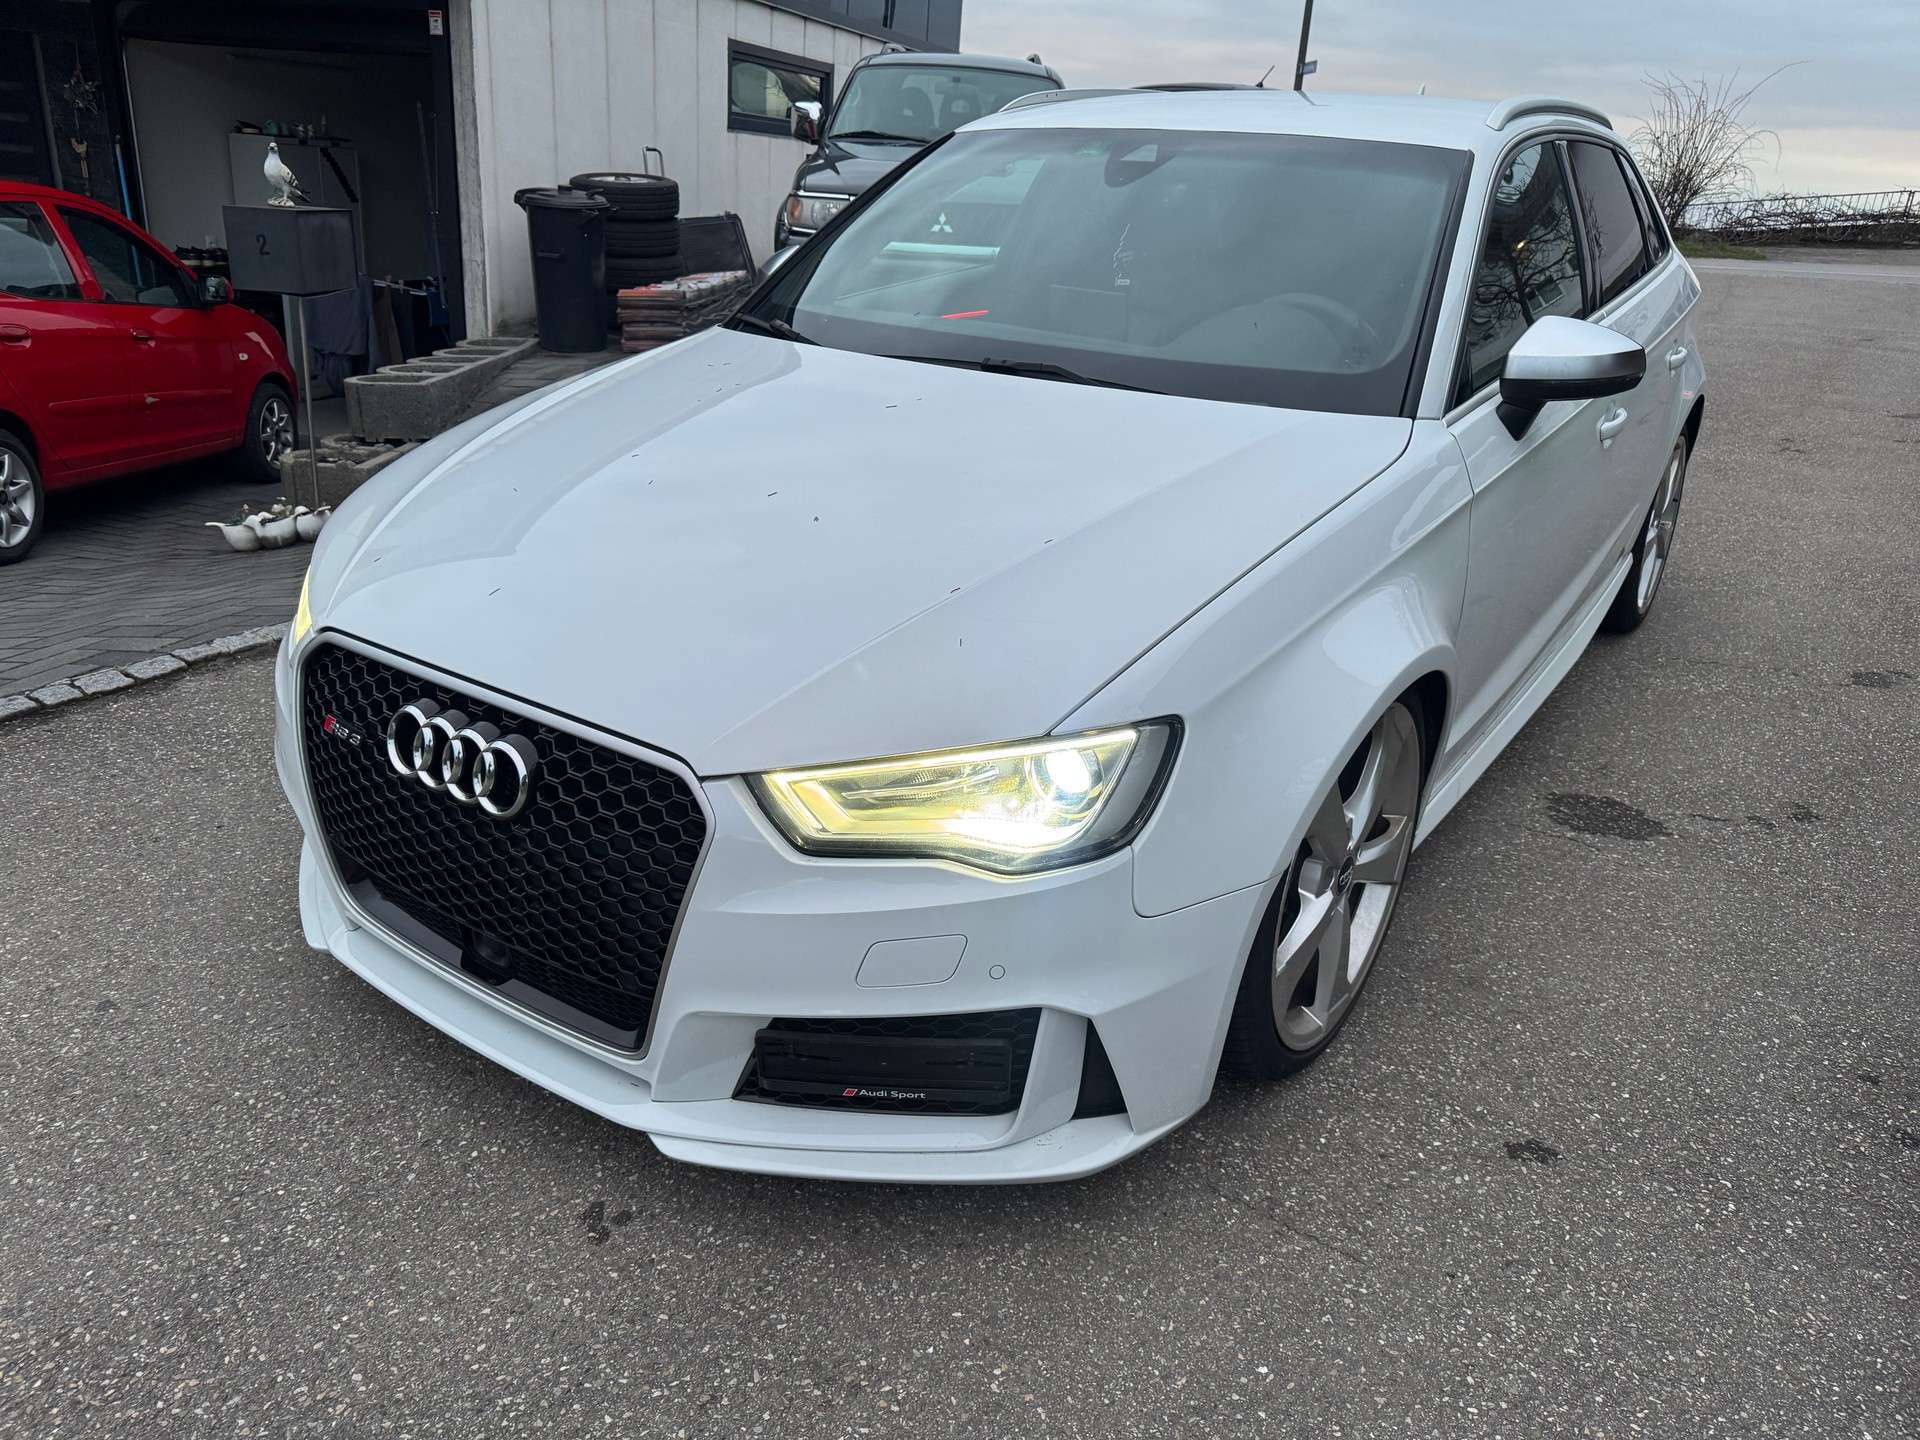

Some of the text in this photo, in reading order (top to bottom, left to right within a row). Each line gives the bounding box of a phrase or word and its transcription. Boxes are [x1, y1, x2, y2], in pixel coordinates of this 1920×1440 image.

[256, 233, 271, 256] 2
[349, 733, 361, 746] 3
[859, 1089, 926, 1099] Audi Sport
